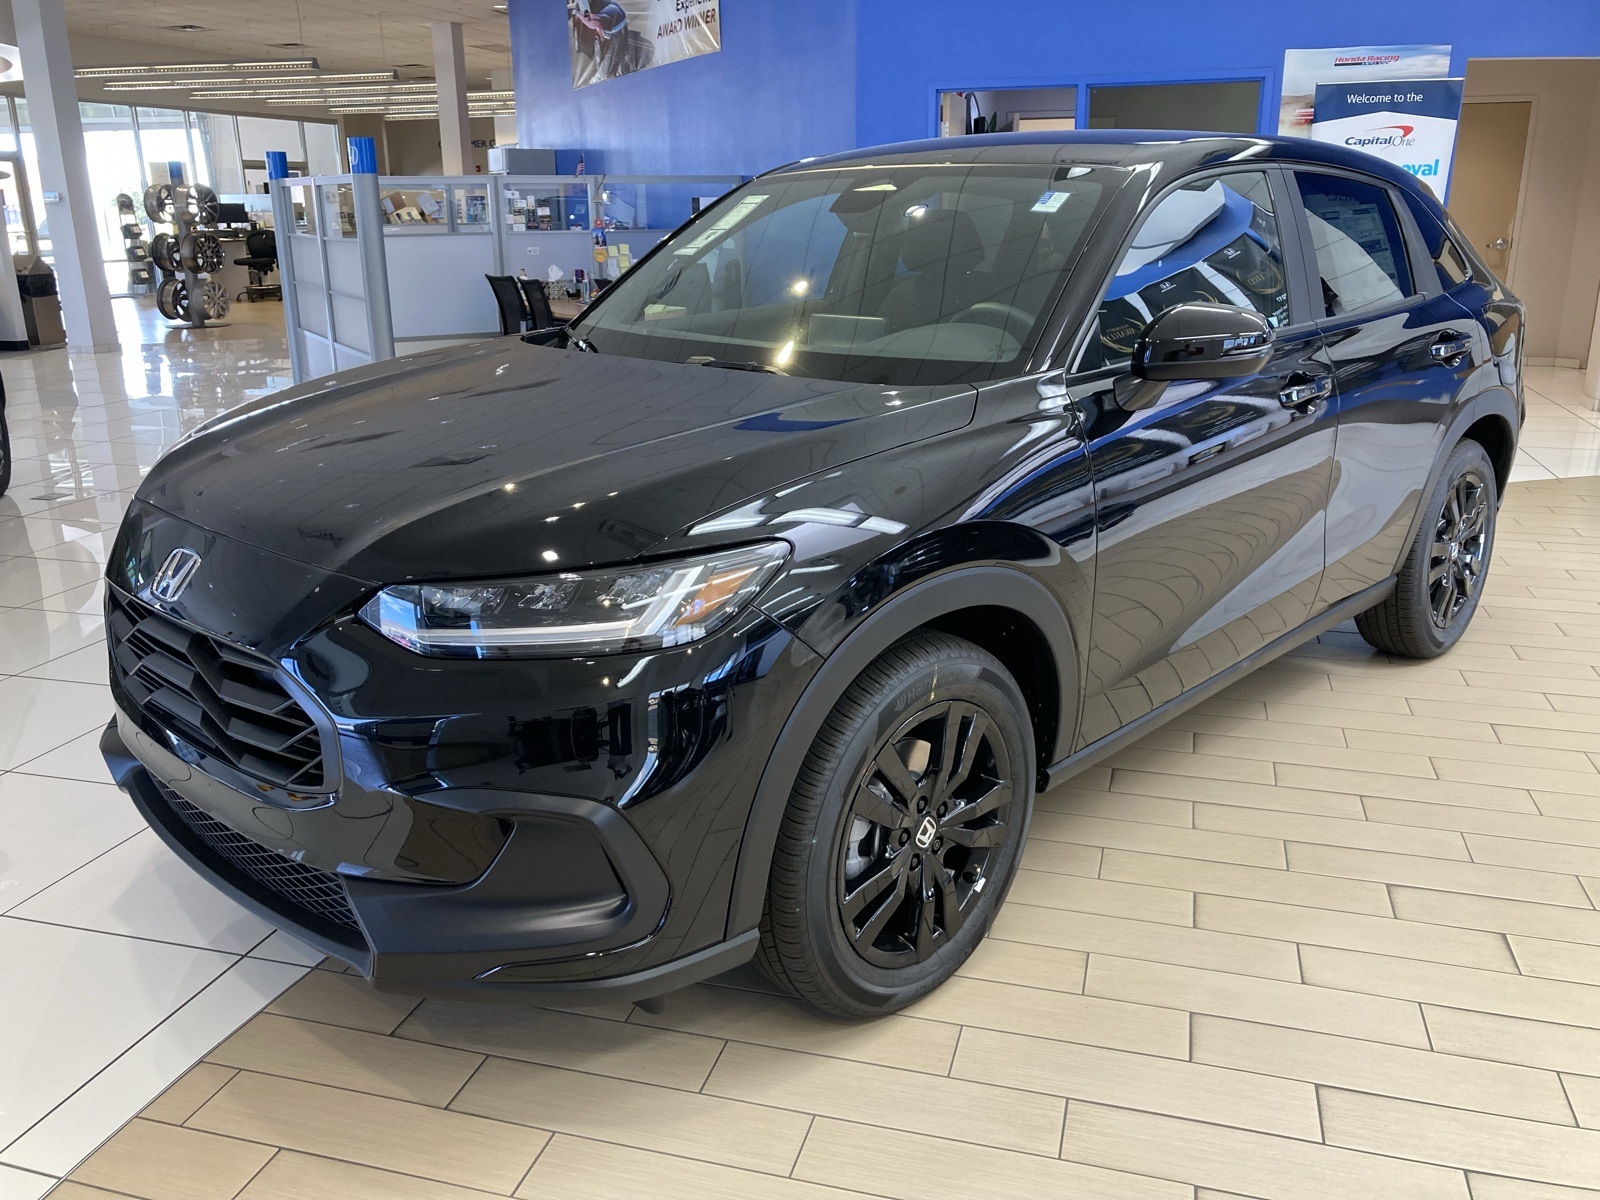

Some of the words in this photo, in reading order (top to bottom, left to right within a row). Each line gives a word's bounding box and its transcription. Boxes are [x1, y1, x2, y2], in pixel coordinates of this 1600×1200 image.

[657, 19, 683, 39] AWARD
[684, 8, 716, 30] WINNER
[1347, 94, 1391, 104] Welcome
[1394, 94, 1404, 102] to
[1407, 92, 1423, 102] the
